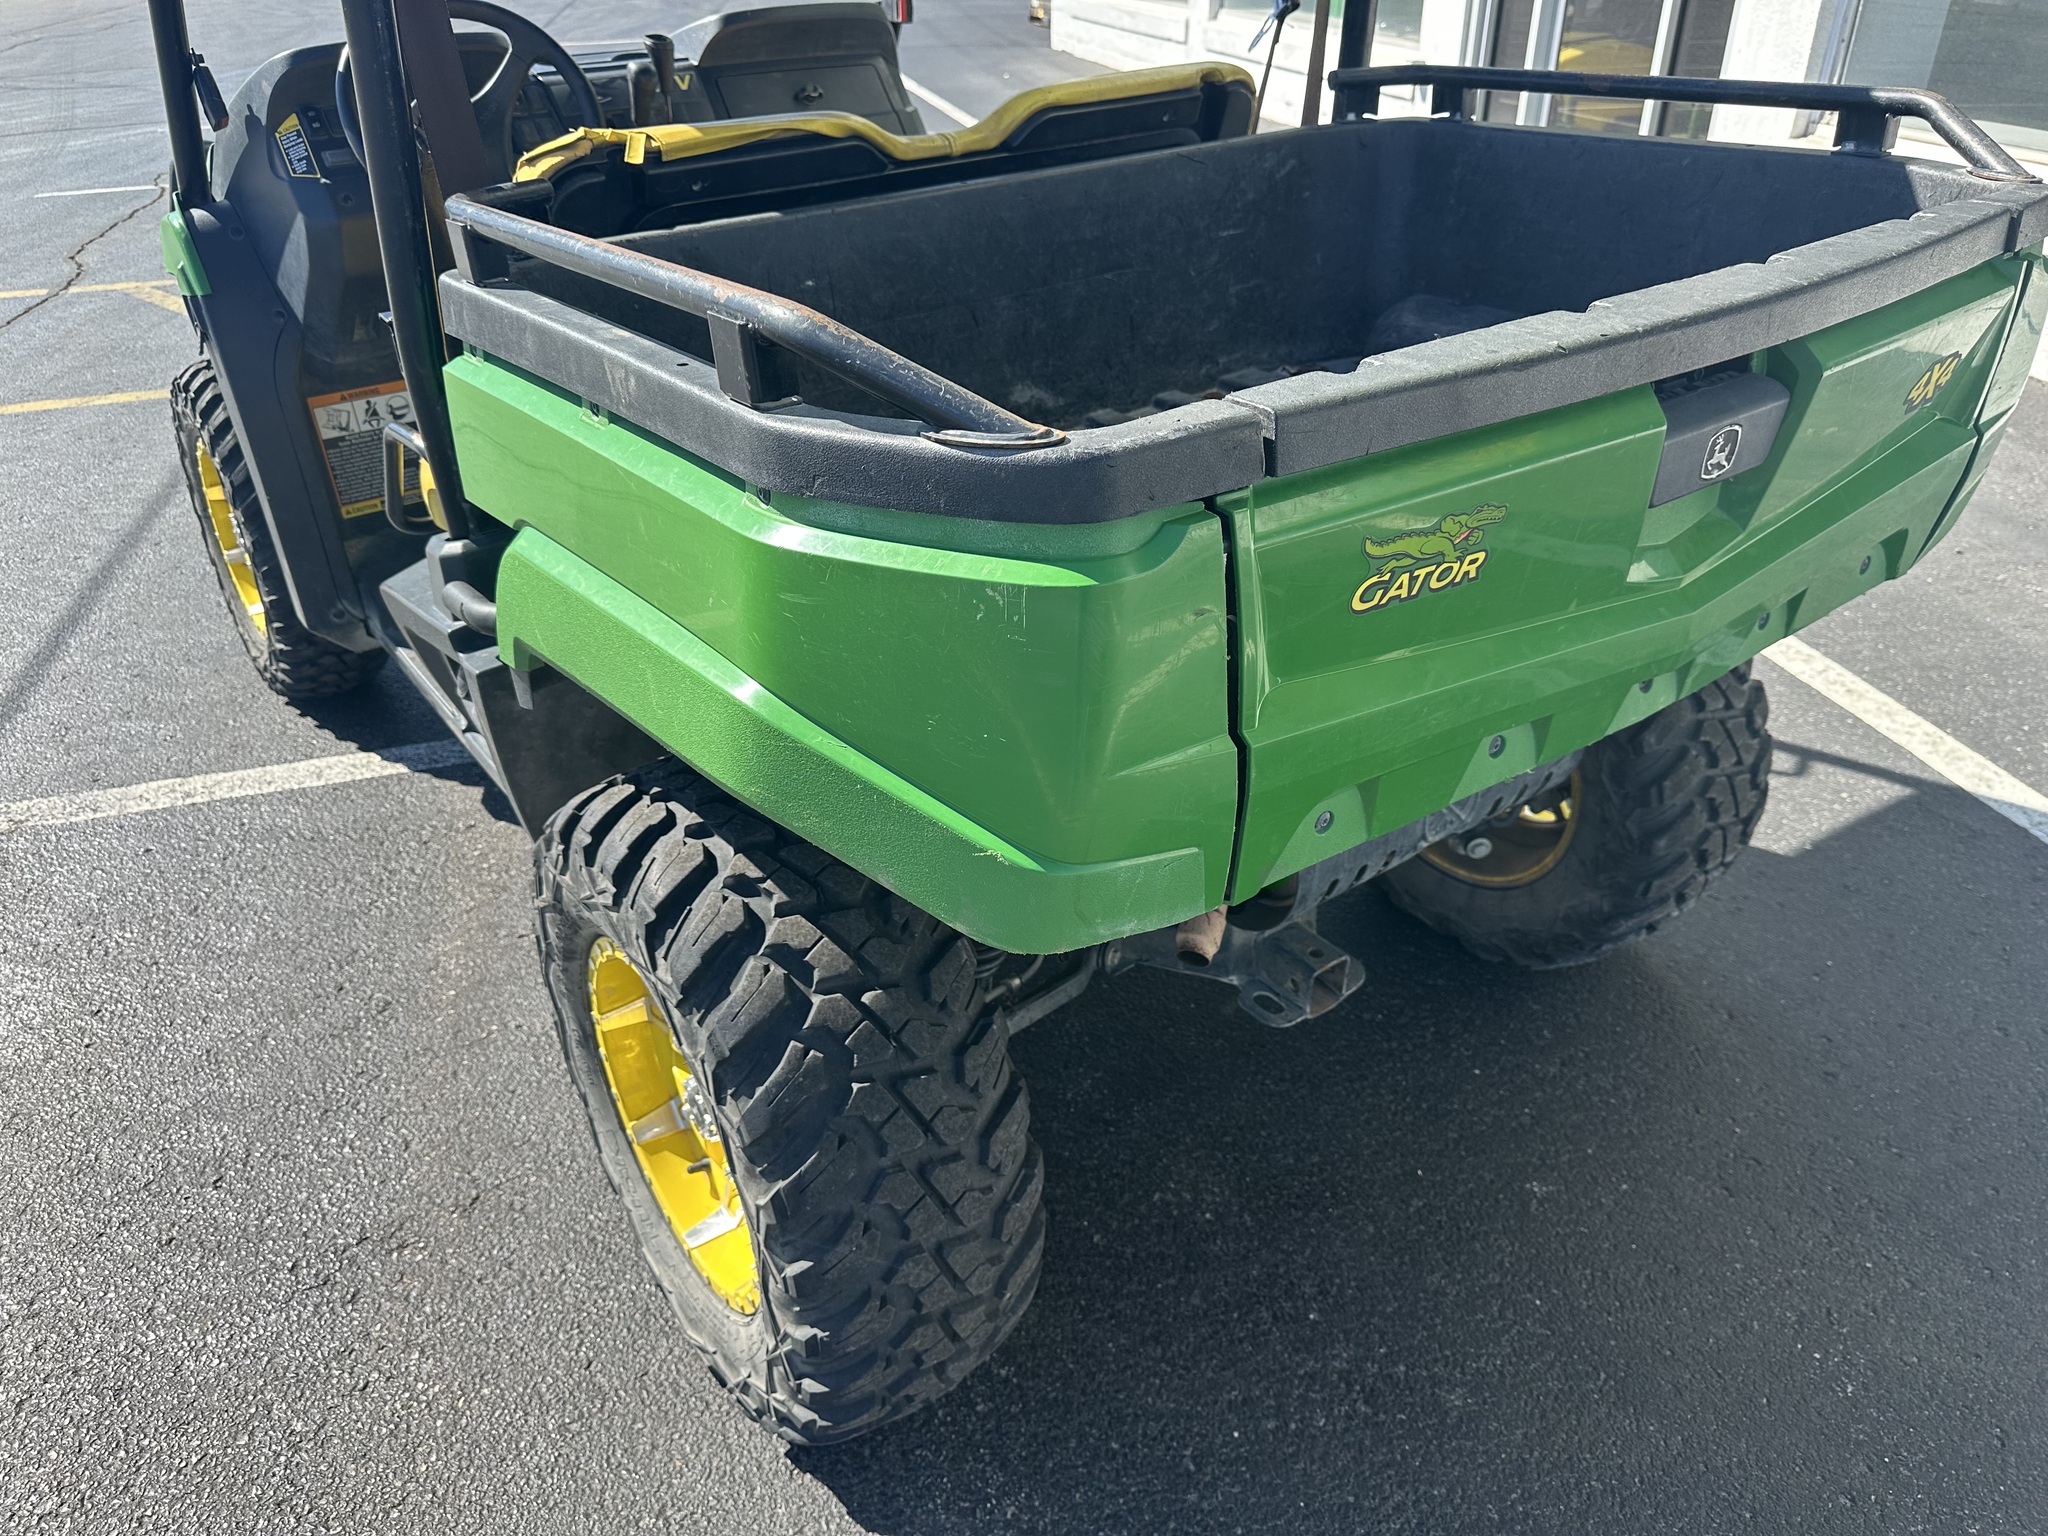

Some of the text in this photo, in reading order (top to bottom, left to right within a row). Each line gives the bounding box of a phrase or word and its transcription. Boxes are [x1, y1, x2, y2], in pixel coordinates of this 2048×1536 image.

[347, 387, 381, 400] WARNING
[352, 502, 379, 514] CAUTION
[1350, 549, 1488, 613] GATOR
